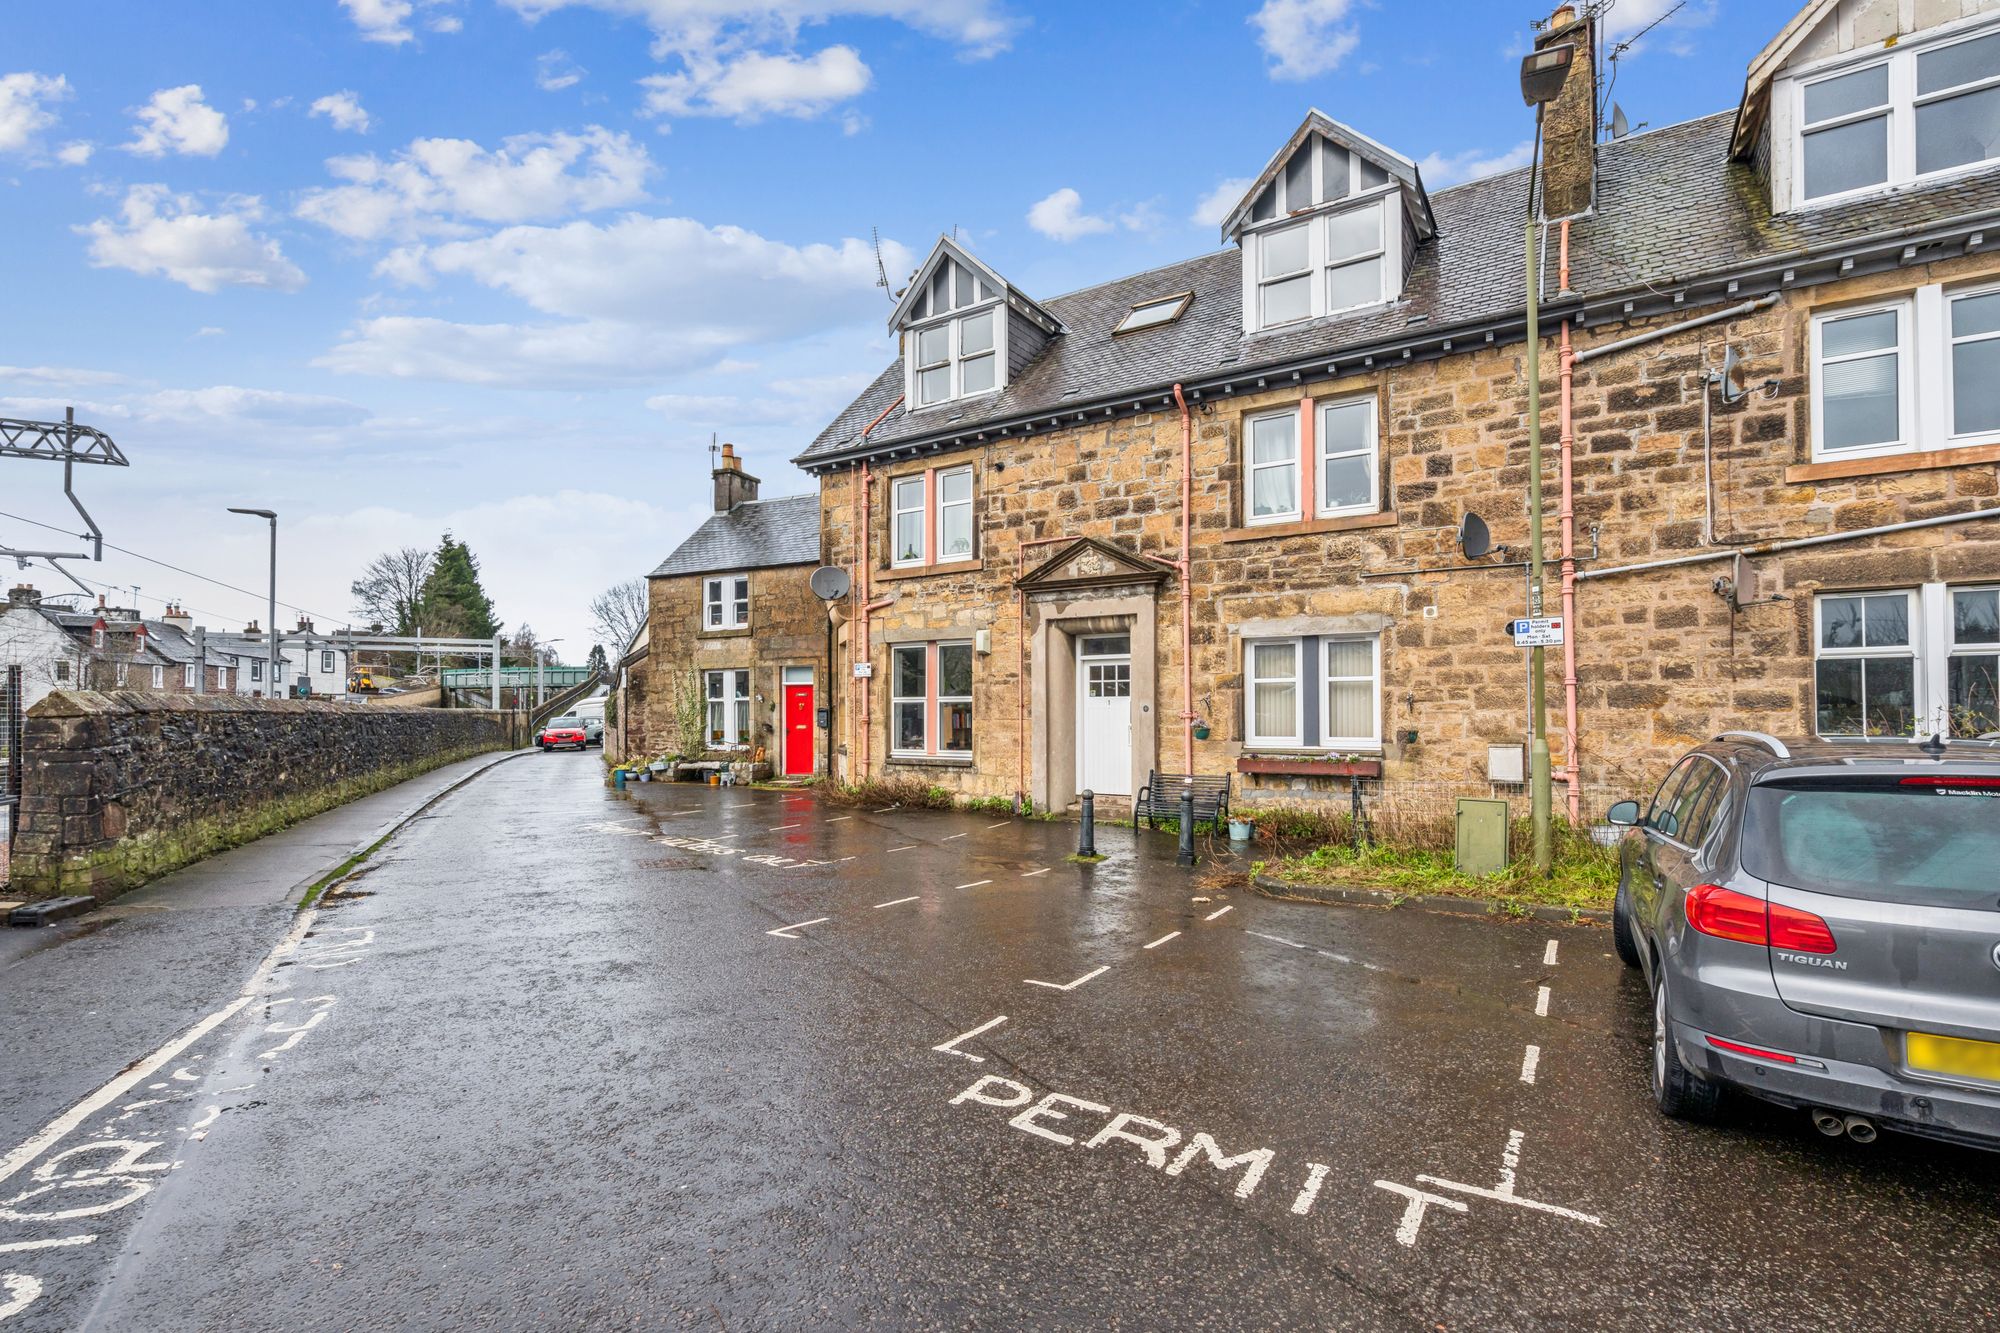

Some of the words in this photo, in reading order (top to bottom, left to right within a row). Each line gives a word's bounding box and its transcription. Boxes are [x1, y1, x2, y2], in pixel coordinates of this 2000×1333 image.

[1519, 622, 1528, 633] P
[1777, 952, 1848, 970] TIGUAN
[948, 1074, 1469, 1246] PERMIT
